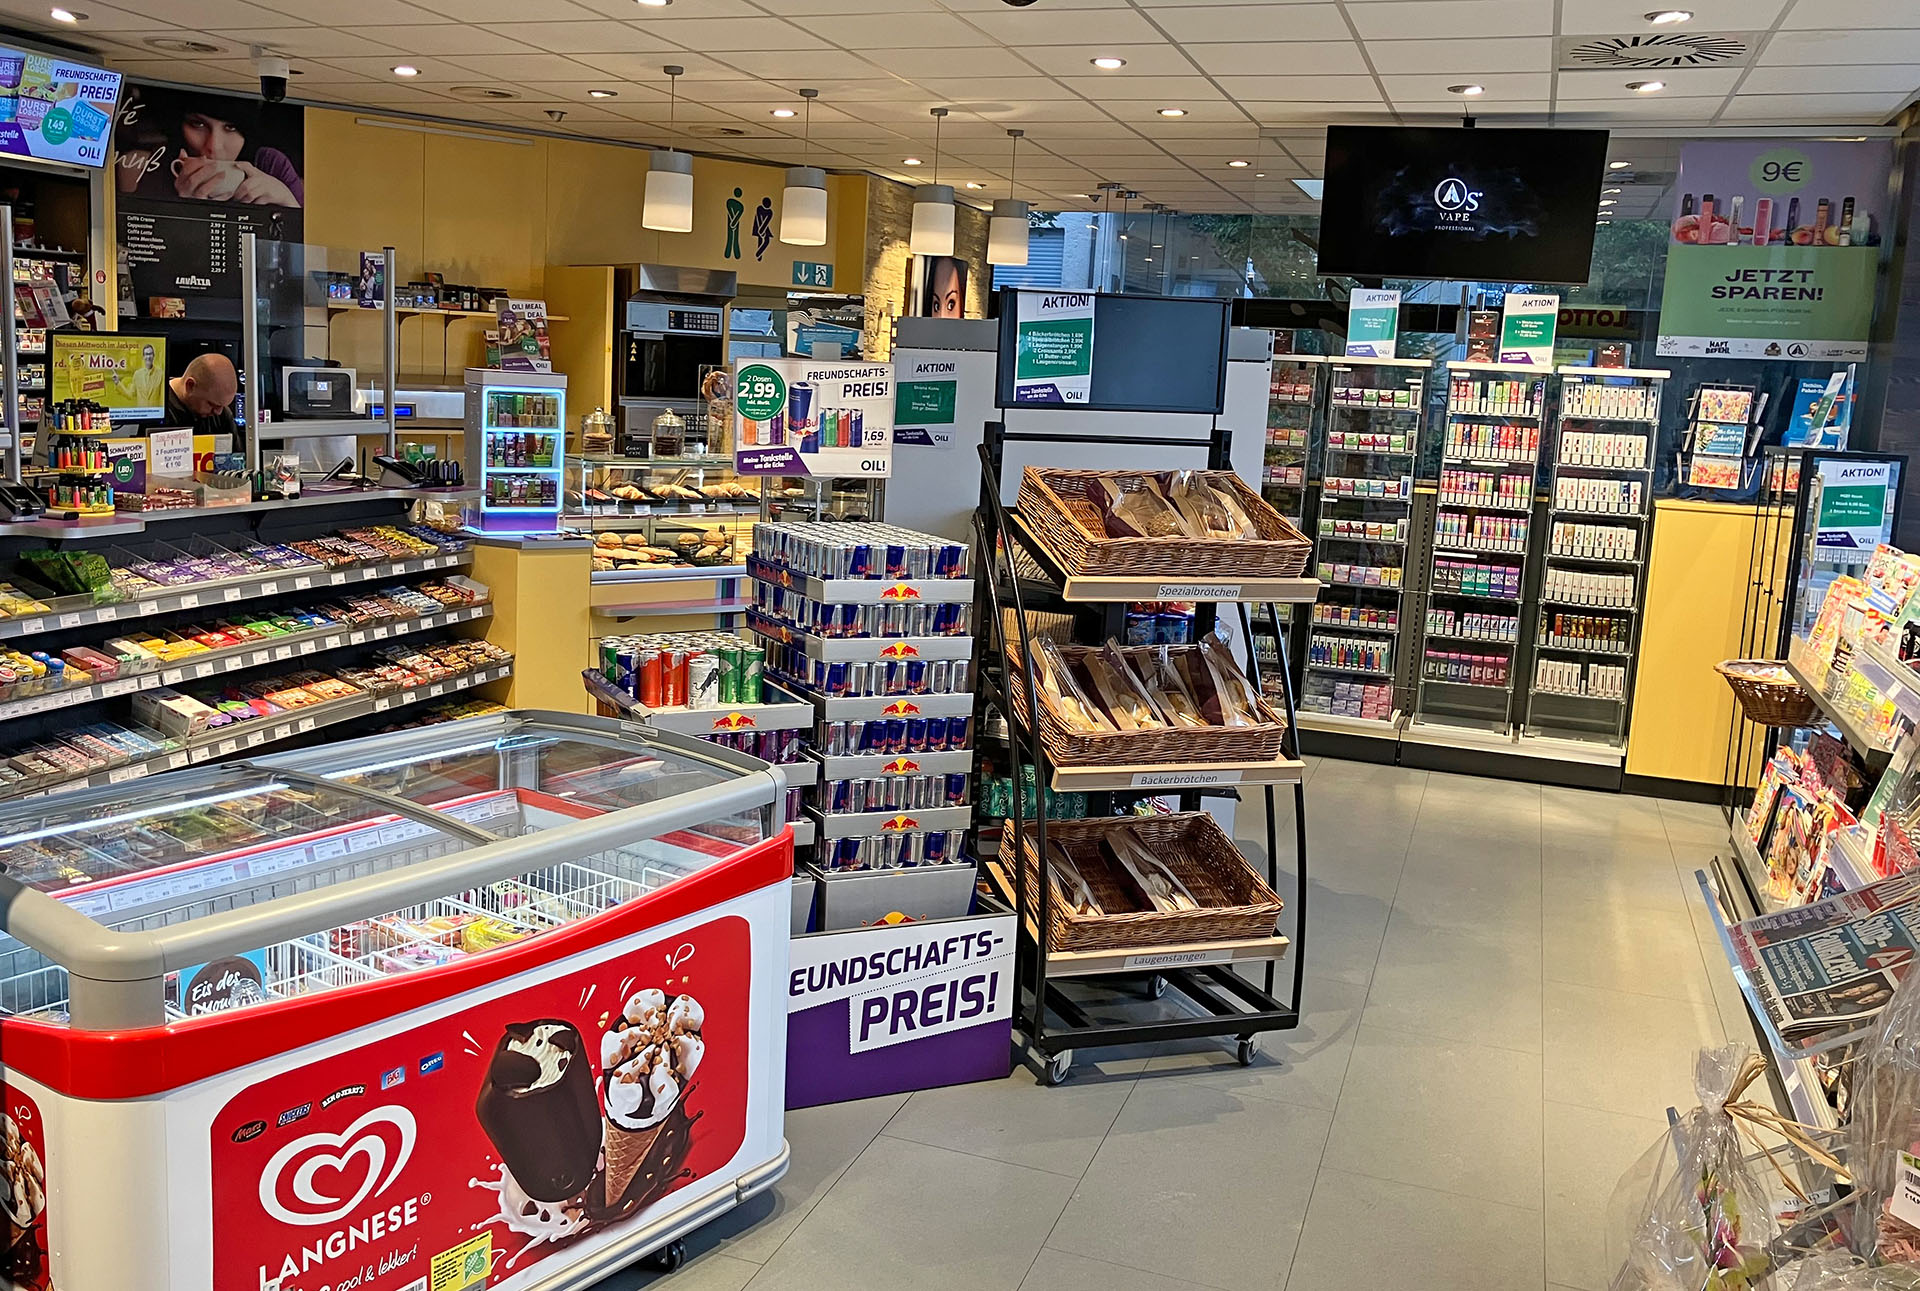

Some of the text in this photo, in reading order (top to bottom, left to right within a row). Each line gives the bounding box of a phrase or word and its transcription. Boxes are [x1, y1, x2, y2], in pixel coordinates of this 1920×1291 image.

[55, 68, 120, 83] FREUNDSCHAFTS-
[80, 85, 117, 100] PREIS!
[75, 105, 104, 127] DURST
[78, 145, 101, 160] OIL!
[1762, 161, 1804, 182] 9€
[1440, 212, 1470, 221] VAPE
[175, 275, 212, 287] LAVAZZA
[1725, 269, 1814, 283] JETZT
[1366, 294, 1397, 302] AKTION!
[1711, 286, 1824, 301] SPAREN!
[1042, 295, 1090, 309] AKTION!
[1522, 299, 1556, 307] AKTION!
[77, 340, 107, 348] Mittwoch
[1705, 347, 1731, 355] BEFEHL
[54, 359, 67, 368] rd.
[916, 363, 956, 373] AKTION!
[807, 368, 889, 381] FREUNDSCHAFTS-
[843, 382, 888, 398] PREIS!
[1066, 391, 1083, 400] OIL!
[130, 452, 144, 460] BOX!
[759, 453, 794, 462] Tankstelle
[861, 460, 886, 472] OIL!
[1841, 468, 1885, 478] AKTION!
[1159, 585, 1239, 599] Spezialbrötchen
[1140, 773, 1217, 786] Bäckerbrötchen
[789, 930, 1004, 996] EUNDSCHAFTS-
[1134, 950, 1206, 966] Laugenstangen
[192, 970, 241, 1001] Eis des
[859, 971, 999, 1042] PREIS!
[420, 1056, 443, 1071] OREO
[322, 1095, 336, 1108] BEN
[340, 1085, 365, 1097] JERRY'S
[279, 1103, 312, 1124] SNICKERS
[234, 1121, 263, 1142] Mars
[259, 1197, 418, 1291] LANGNESE
[336, 1266, 362, 1291] cool
[365, 1266, 375, 1280] &
[378, 1244, 418, 1275] lekker!
